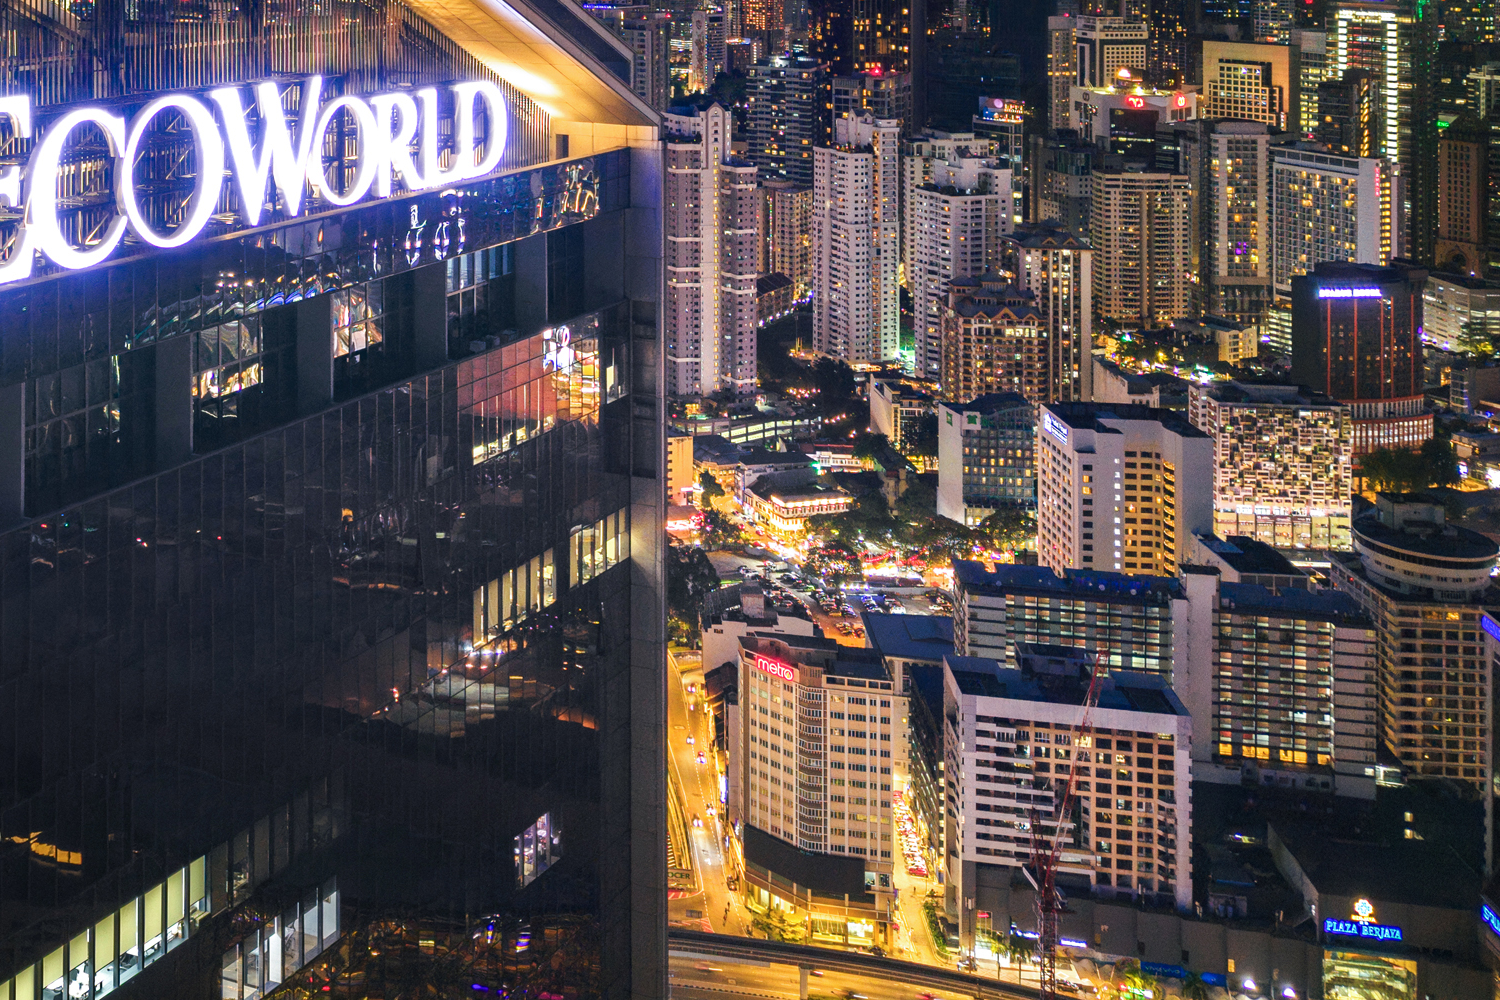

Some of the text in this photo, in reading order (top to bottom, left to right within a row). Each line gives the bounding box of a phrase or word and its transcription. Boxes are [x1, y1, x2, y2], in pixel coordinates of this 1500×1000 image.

[758, 658, 793, 680] metro
[1325, 919, 1403, 941] PLAZA BERJAYA
